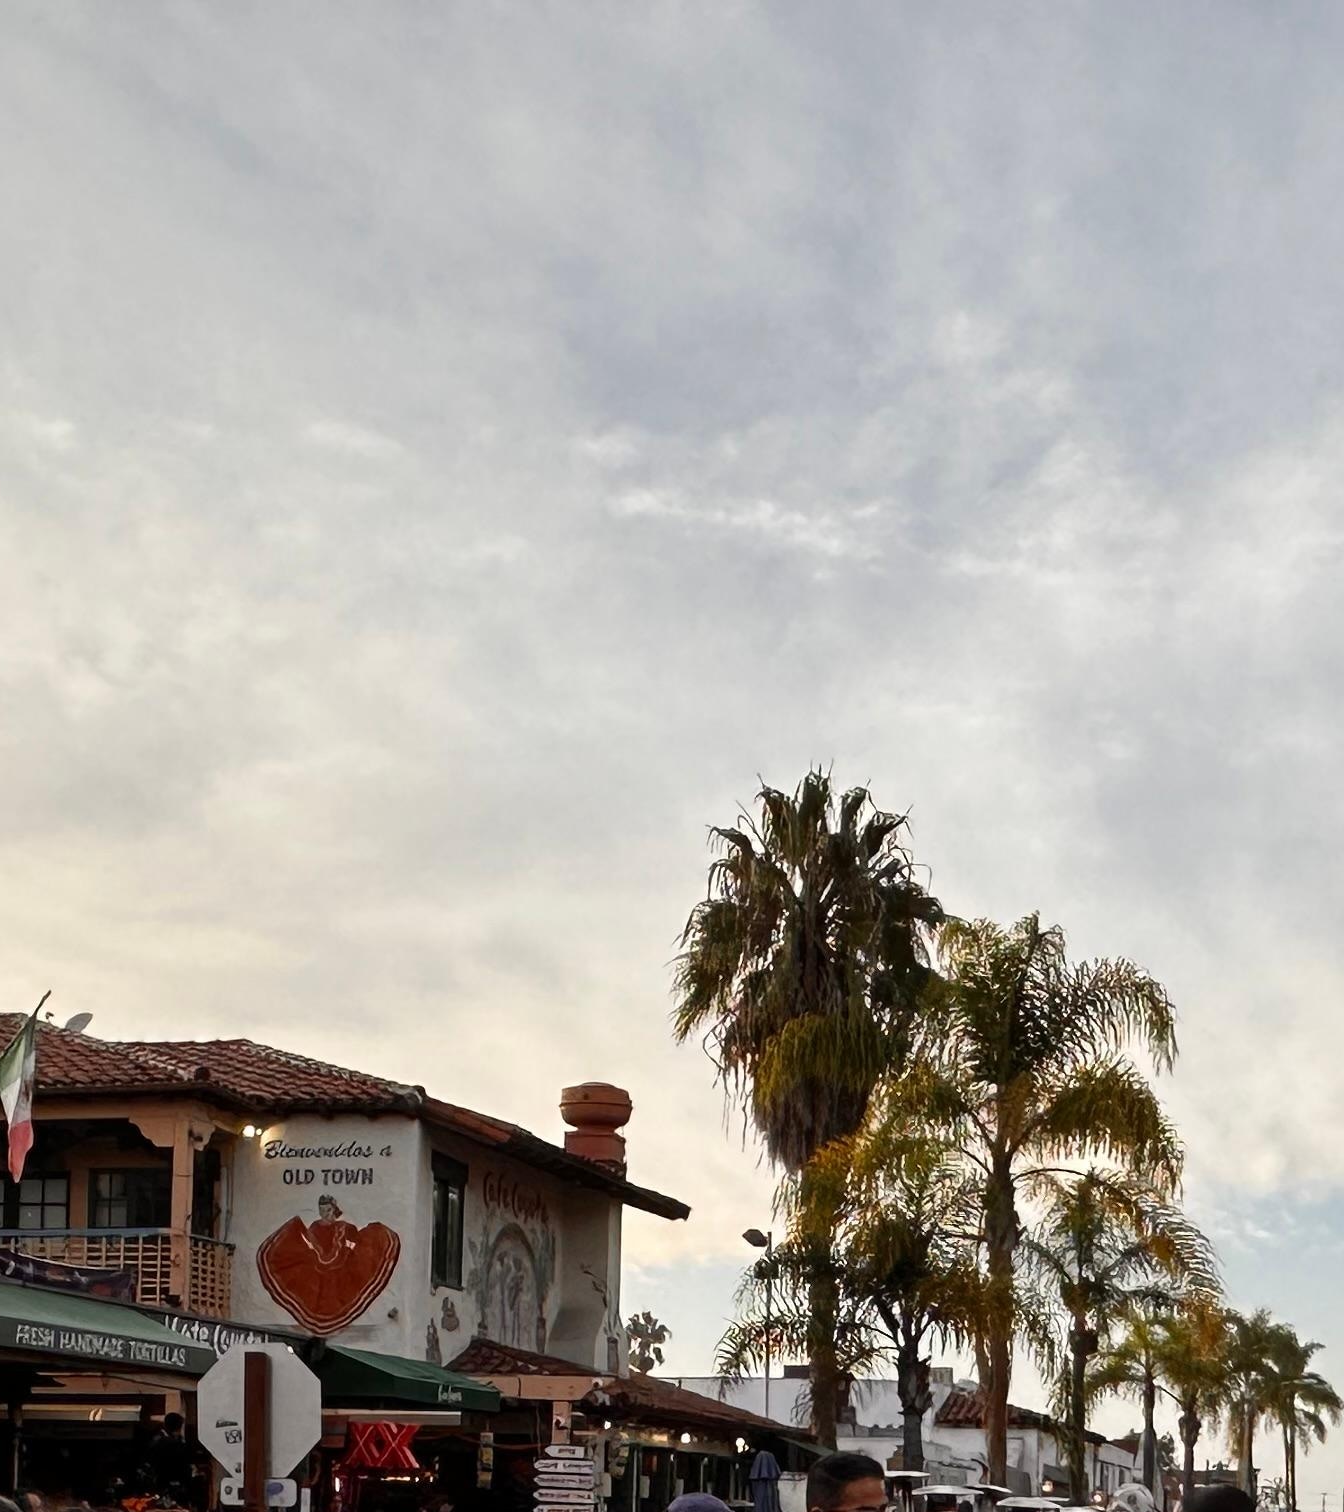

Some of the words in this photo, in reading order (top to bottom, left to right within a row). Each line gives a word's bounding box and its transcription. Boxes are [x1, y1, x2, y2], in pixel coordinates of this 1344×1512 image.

[264, 1139, 373, 1160] Bienvenidos
[379, 1144, 393, 1158] a
[282, 1168, 315, 1186] OLD
[321, 1167, 374, 1186] TOWN
[15, 1323, 55, 1348] FRESH
[59, 1330, 126, 1359] HANDMADE
[129, 1340, 187, 1367] TORTILLAS
